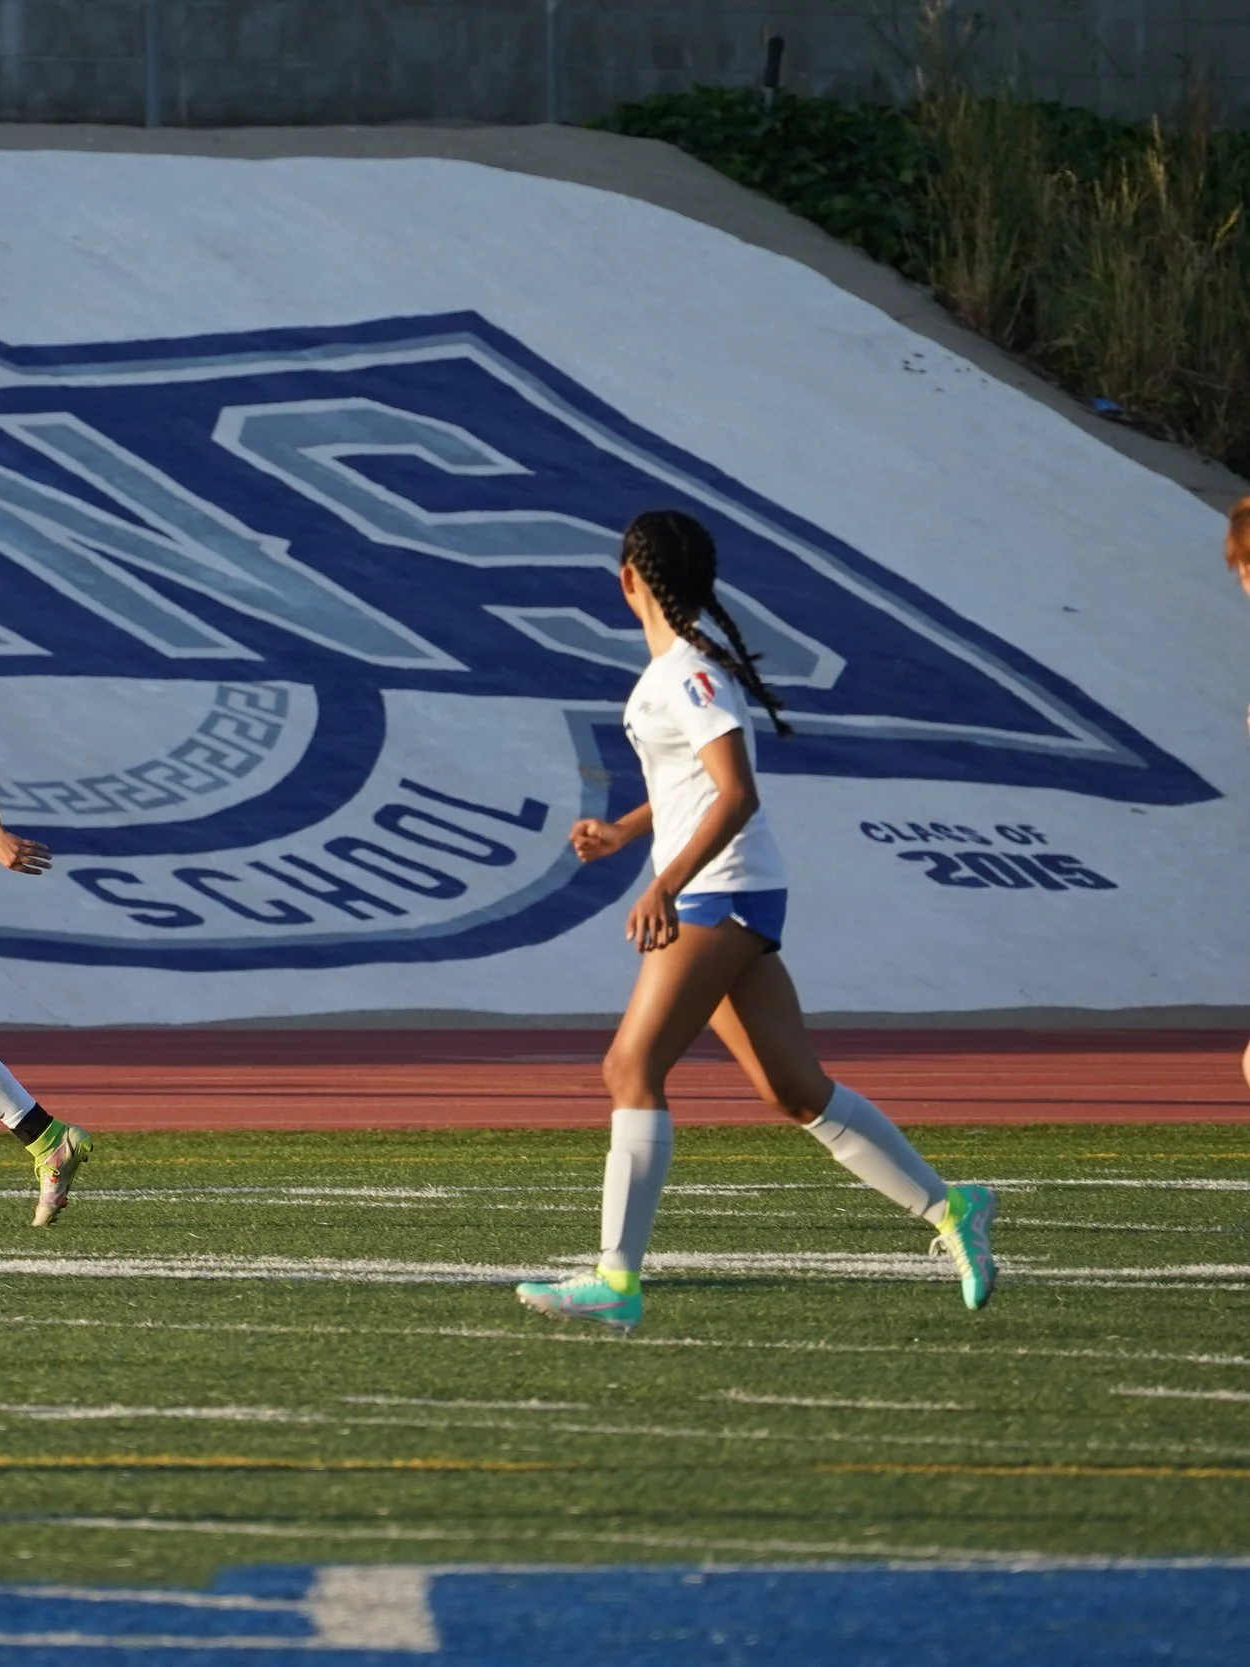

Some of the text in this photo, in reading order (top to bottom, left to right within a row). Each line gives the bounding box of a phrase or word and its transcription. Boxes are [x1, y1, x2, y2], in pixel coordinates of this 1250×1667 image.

[67, 778, 550, 929] SCHOOL
[859, 820, 1049, 846] CLASS OF
[896, 849, 1119, 891] 2015
